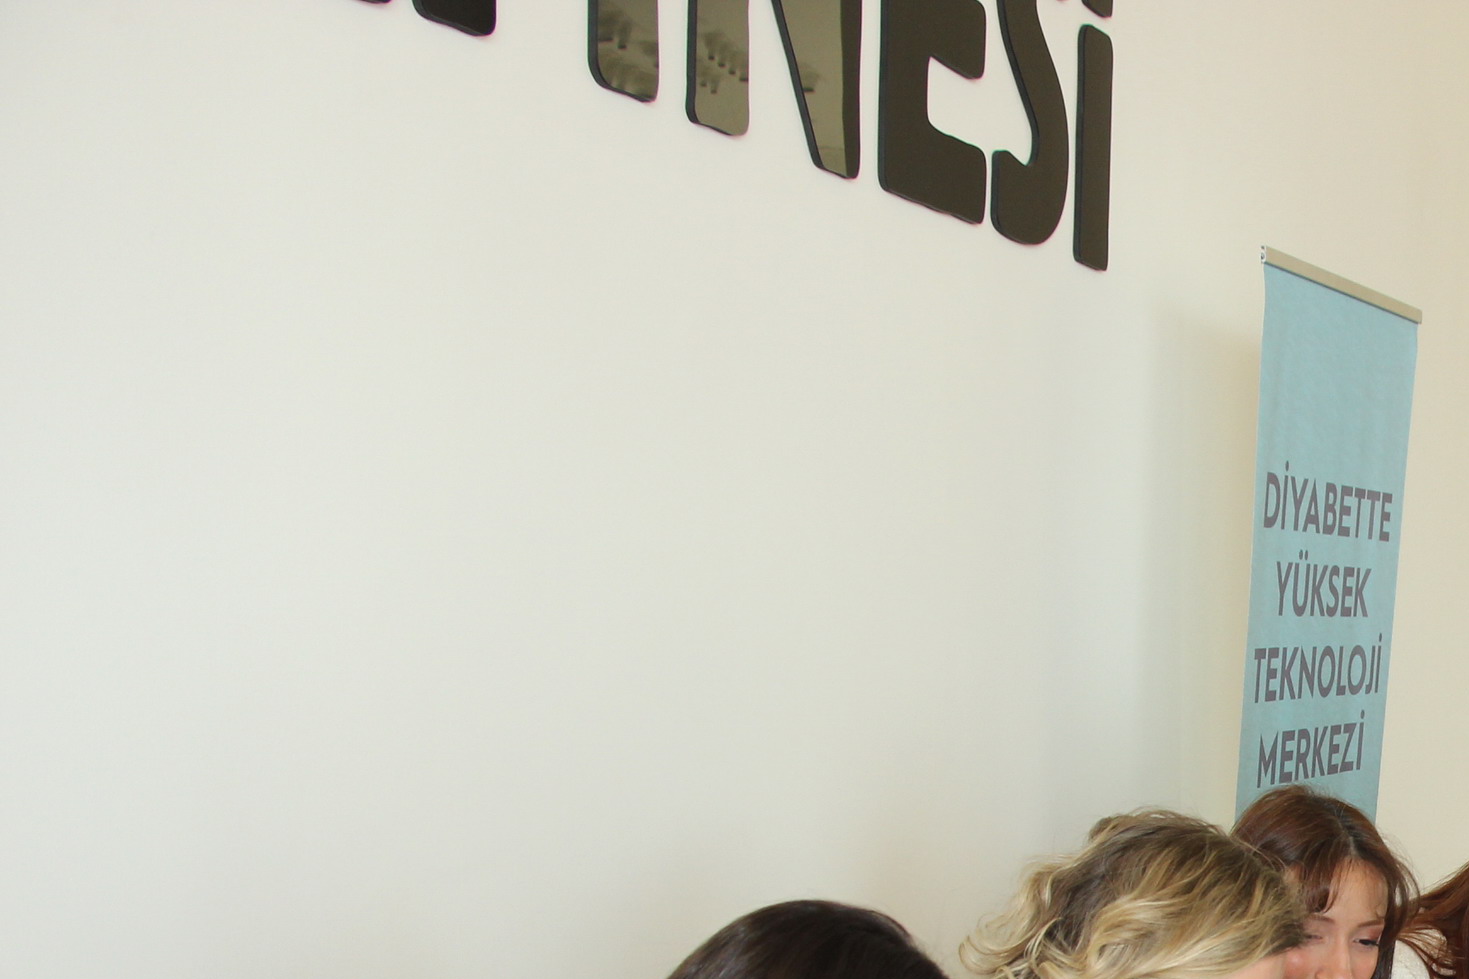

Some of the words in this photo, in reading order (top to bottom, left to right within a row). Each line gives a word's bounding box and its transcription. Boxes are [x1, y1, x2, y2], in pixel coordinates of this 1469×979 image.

[1263, 460, 1393, 542] DİYABETTE
[1276, 549, 1372, 618] YÜKSEK
[1254, 632, 1383, 704] TEKNOLOJİ
[1257, 709, 1366, 789] MERKEZİ
